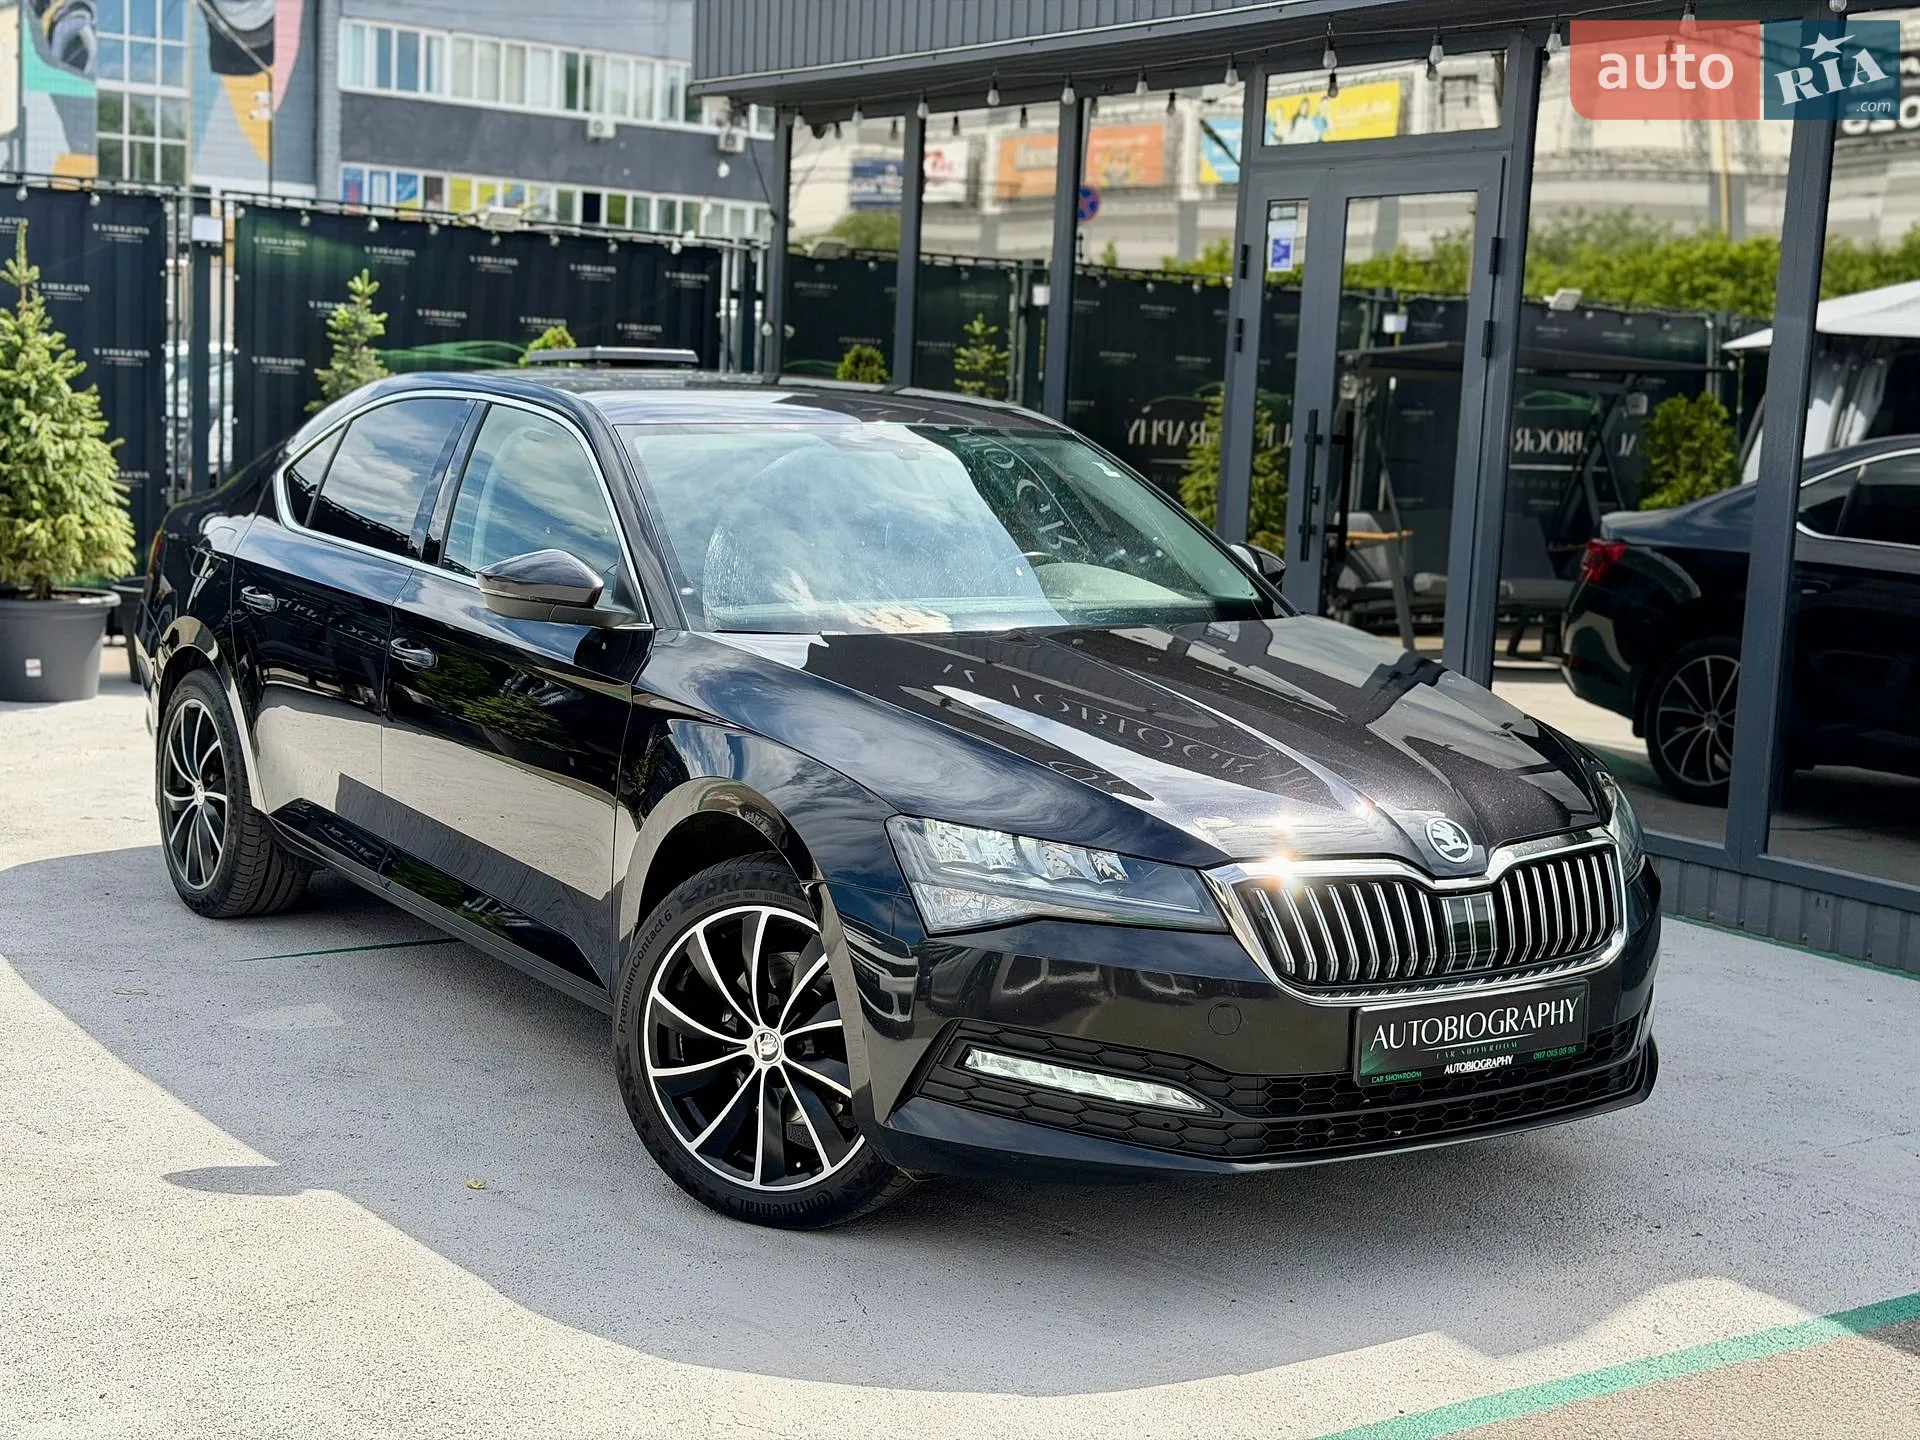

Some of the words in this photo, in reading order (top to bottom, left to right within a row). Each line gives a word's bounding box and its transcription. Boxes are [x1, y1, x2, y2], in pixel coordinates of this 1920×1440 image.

[617, 921, 666, 1034] PremiumContact
[664, 909, 673, 922] 6
[1369, 997, 1579, 1052] AUTOBIOGRAPHY
[1371, 1075, 1384, 1084] CAR
[1385, 1071, 1422, 1082] SHOWROOM
[1443, 1054, 1514, 1076] AUTOBIOGRAPHY
